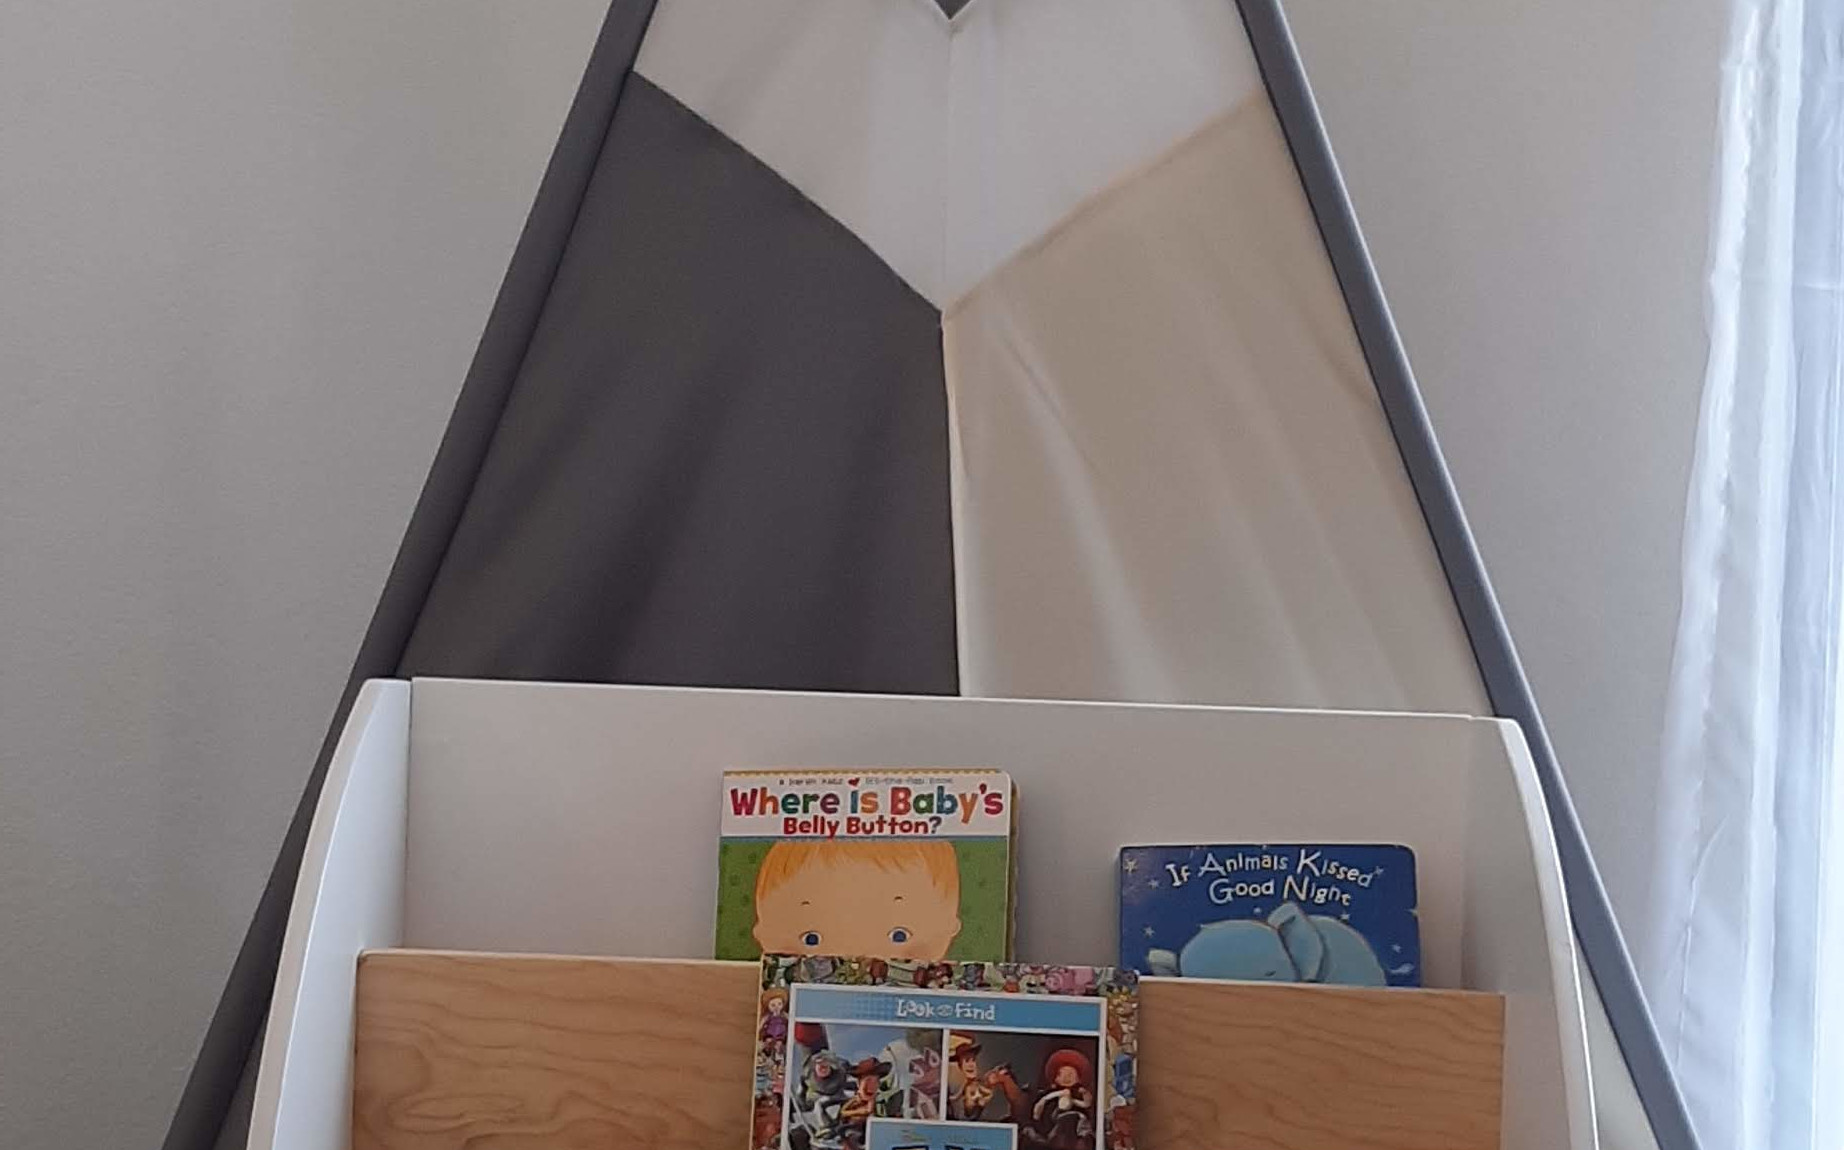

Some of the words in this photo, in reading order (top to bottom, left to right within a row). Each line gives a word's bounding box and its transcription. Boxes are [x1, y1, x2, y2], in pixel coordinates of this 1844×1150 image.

[730, 787, 840, 816] Where
[849, 780, 880, 814] is
[889, 783, 1004, 824] Baby's
[783, 816, 840, 840] Belly
[846, 816, 942, 835] Button?
[1165, 863, 1191, 887] If
[1197, 852, 1289, 877] Animals
[1296, 849, 1374, 888] Kissed
[1208, 878, 1275, 905] Good
[1283, 875, 1351, 906] Night
[896, 998, 935, 1018] Look
[955, 1002, 996, 1020] Find
